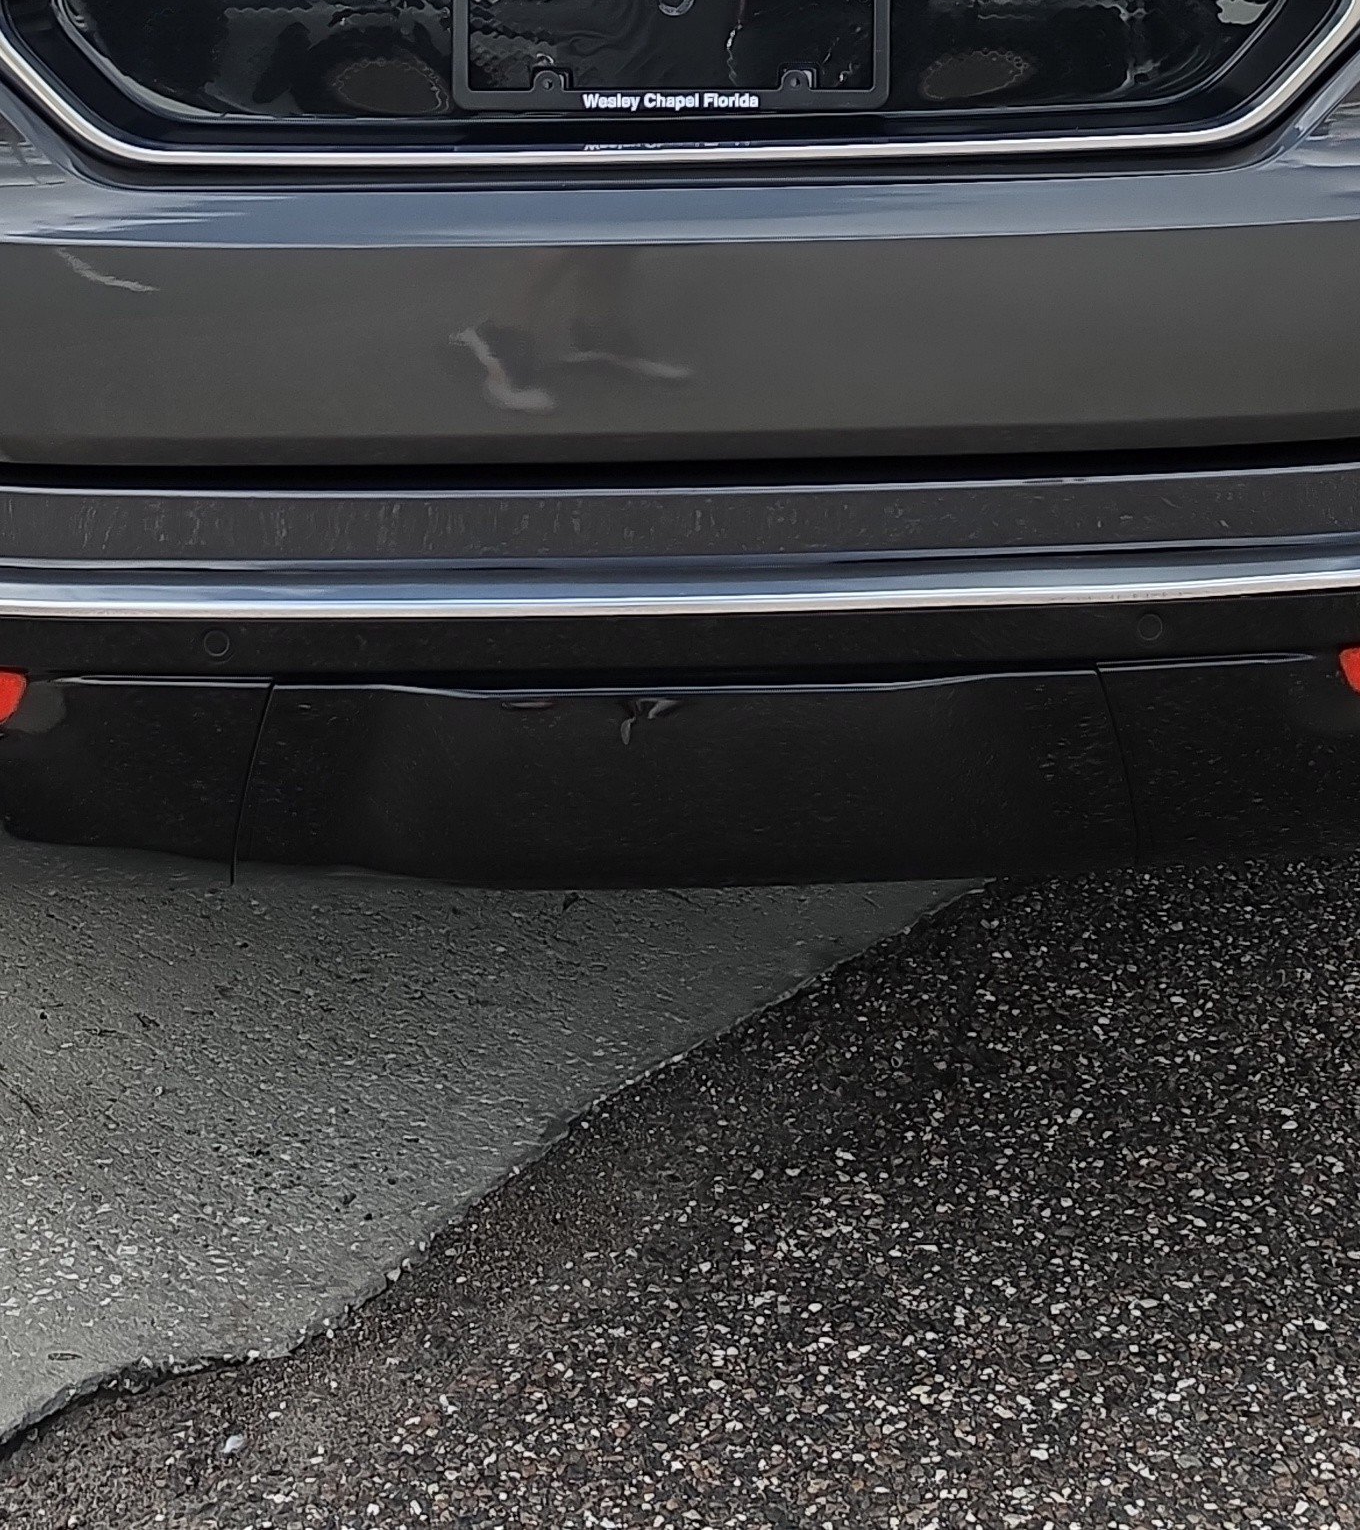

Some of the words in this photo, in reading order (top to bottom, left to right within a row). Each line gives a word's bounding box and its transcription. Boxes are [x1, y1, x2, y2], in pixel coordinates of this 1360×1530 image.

[582, 93, 640, 111] Wesley
[643, 93, 699, 111] Chapel
[703, 93, 759, 108] Florida
